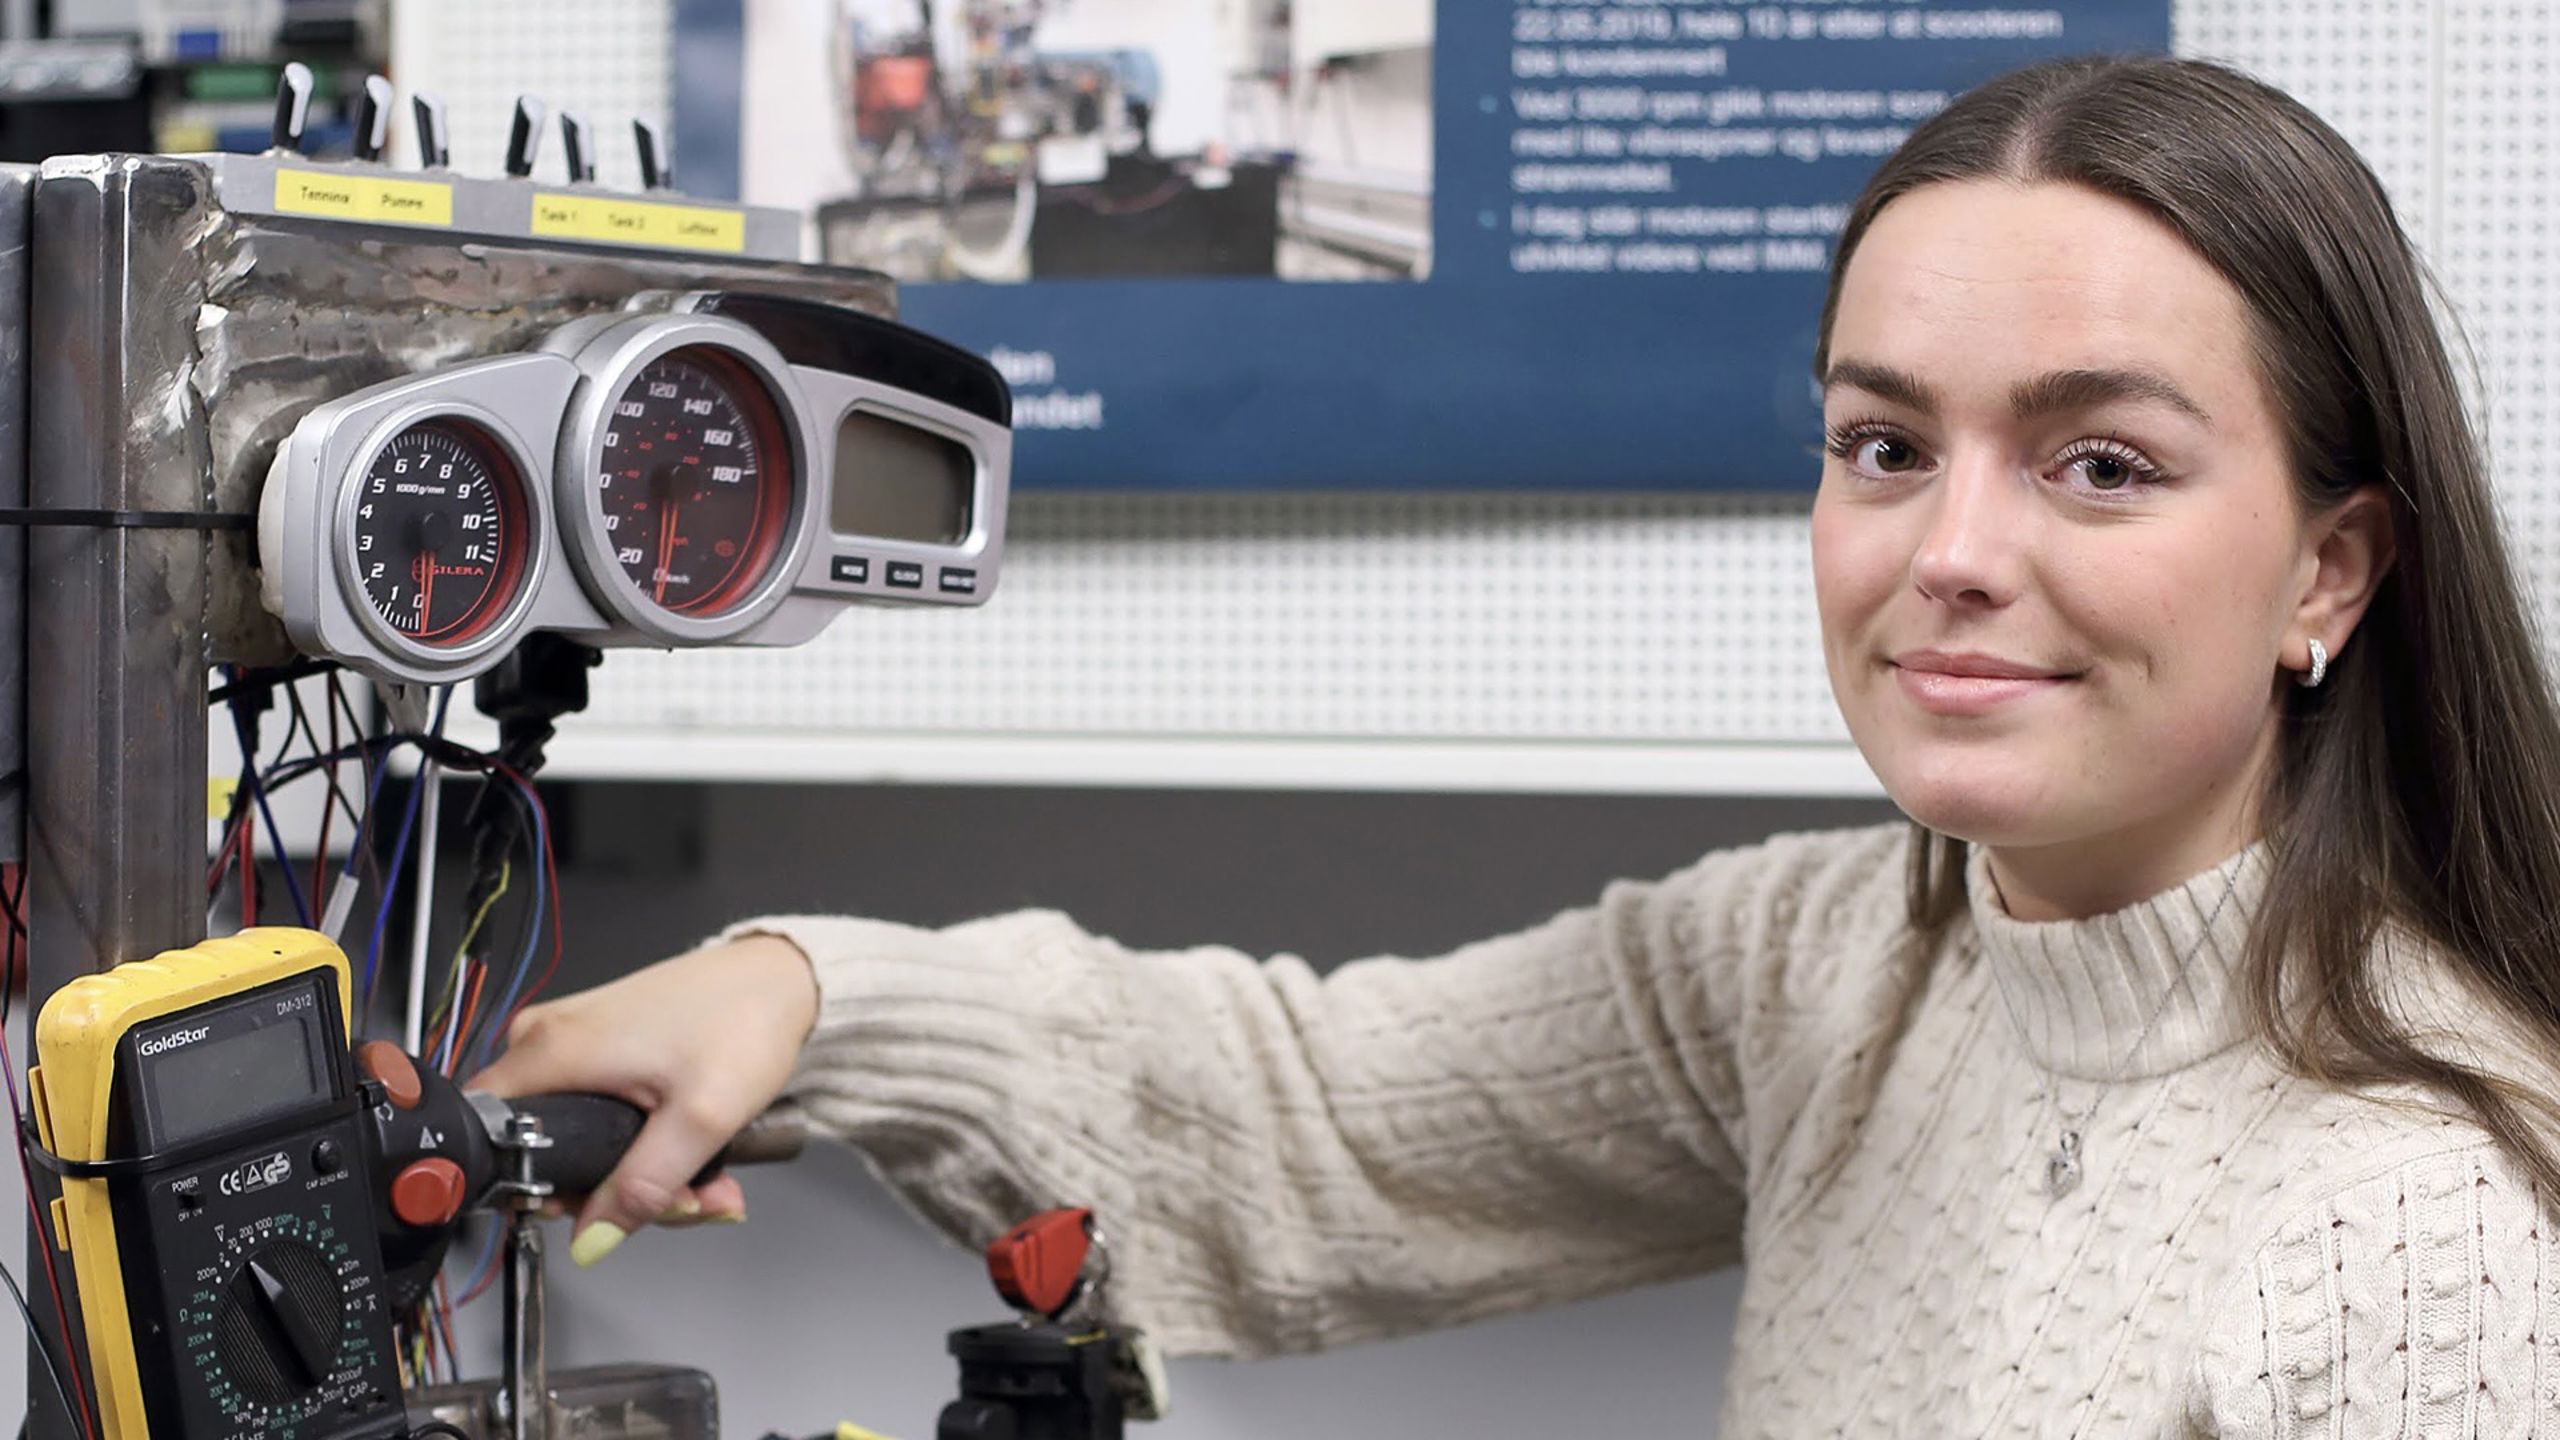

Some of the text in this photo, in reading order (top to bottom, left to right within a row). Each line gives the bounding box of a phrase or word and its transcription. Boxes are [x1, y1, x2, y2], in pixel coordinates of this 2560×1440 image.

[1747, 7, 1786, 40] 10
[1922, 9, 2063, 39] scooteren
[1769, 89, 1885, 119] motoren
[1778, 128, 1820, 162] og
[649, 382, 678, 399] 120
[683, 397, 712, 415] 140
[703, 429, 732, 447] 160
[395, 458, 407, 474] 6
[419, 454, 431, 469] 7
[439, 464, 453, 479] 8
[712, 466, 741, 483] 180
[372, 478, 386, 494] 5
[457, 484, 470, 499] 9
[360, 504, 372, 520] 4
[462, 514, 481, 530] 10
[359, 535, 372, 551] 3
[465, 545, 480, 560] 11
[619, 547, 643, 564] 20
[370, 562, 384, 577] 2
[391, 585, 398, 600] 1
[276, 994, 312, 1016] DM-312
[140, 1026, 210, 1056] GoldStar
[172, 1176, 198, 1193] POWER
[219, 1169, 242, 1196] CE
[178, 1211, 190, 1222] OFF
[255, 1216, 273, 1231] 1000
[239, 1225, 254, 1239] 200
[227, 1237, 238, 1250] 20
[219, 1252, 225, 1263] 2
[196, 1266, 218, 1281] 200m
[343, 1260, 360, 1273] 20m
[349, 1276, 370, 1291] 200m
[353, 1299, 362, 1310] 10
[349, 1381, 368, 1399] CAP
[235, 1411, 252, 1425] NPN
[252, 1415, 268, 1429] PNP
